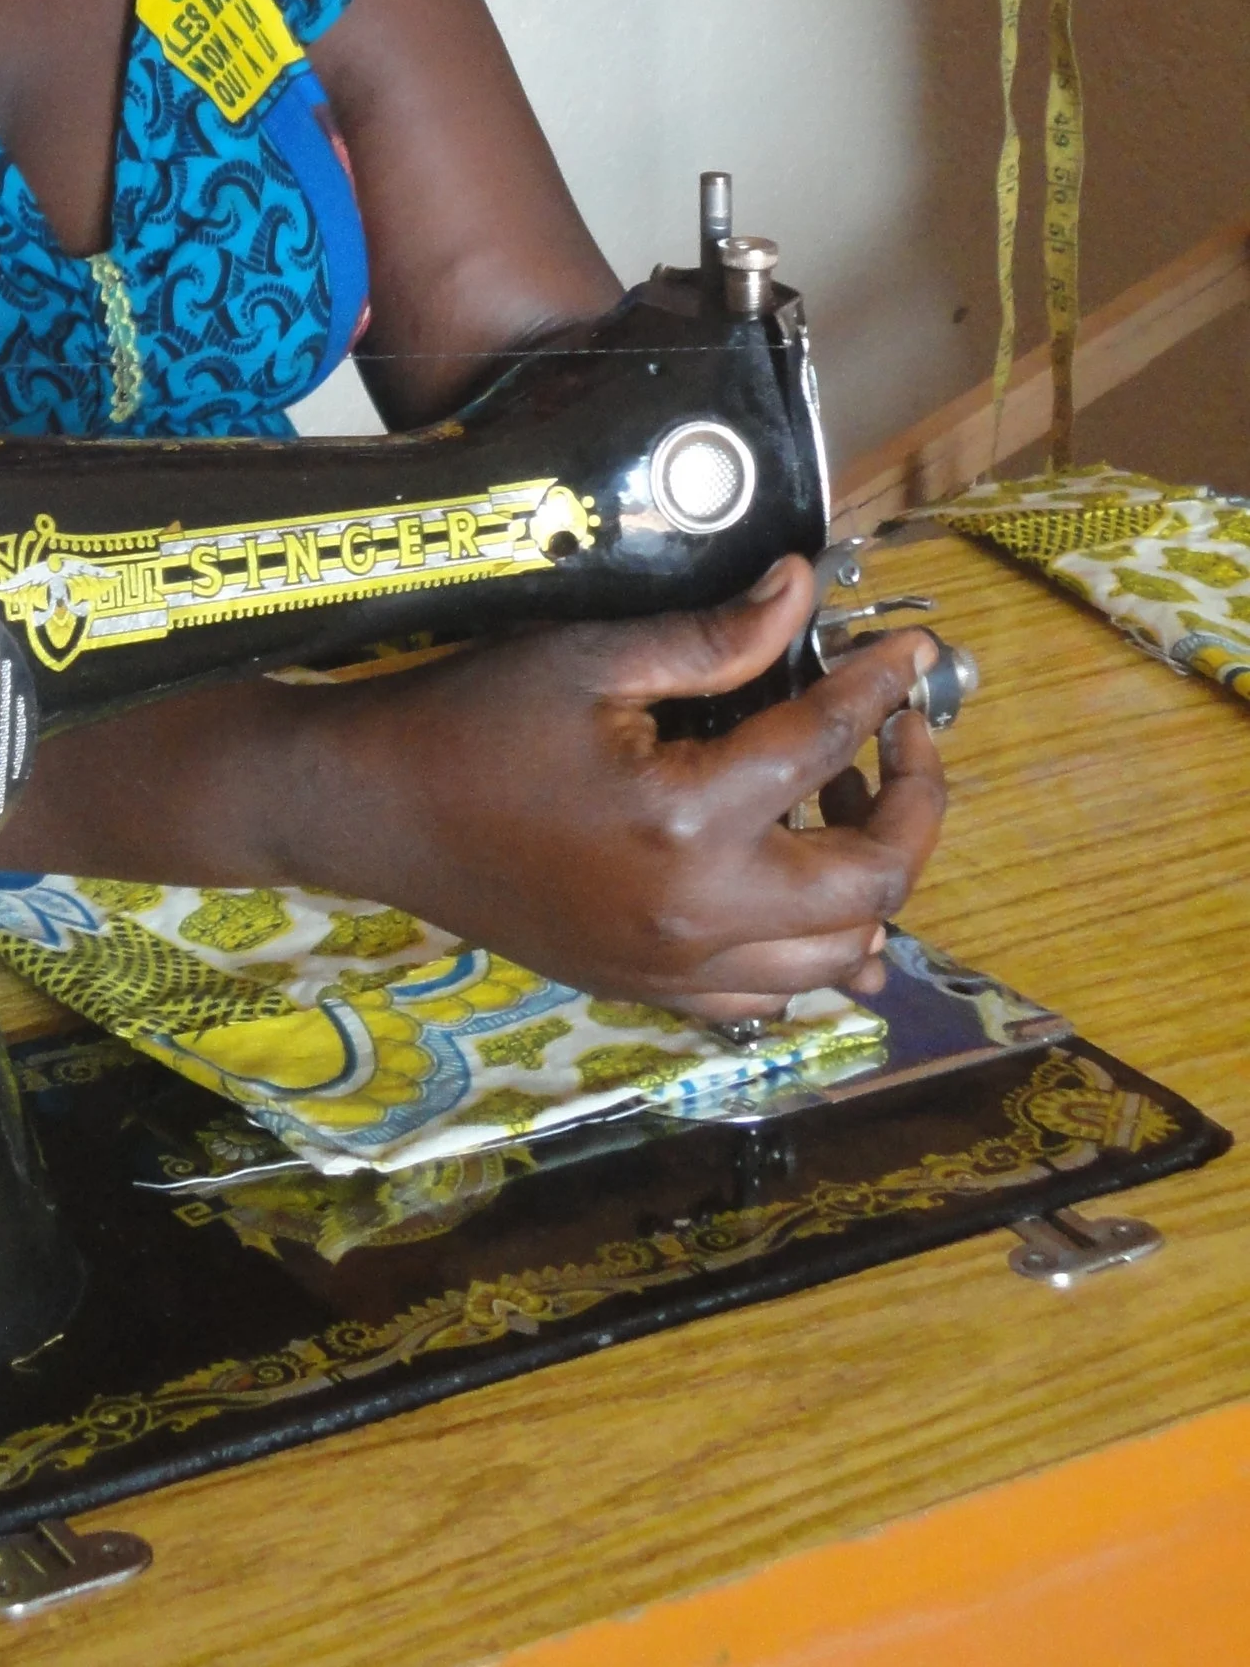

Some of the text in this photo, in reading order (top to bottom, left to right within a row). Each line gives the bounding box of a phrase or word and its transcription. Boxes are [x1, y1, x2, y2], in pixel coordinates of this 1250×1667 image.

[163, 2, 211, 58] LES
[213, 62, 252, 108] OUI
[190, 509, 482, 598] SINGER
